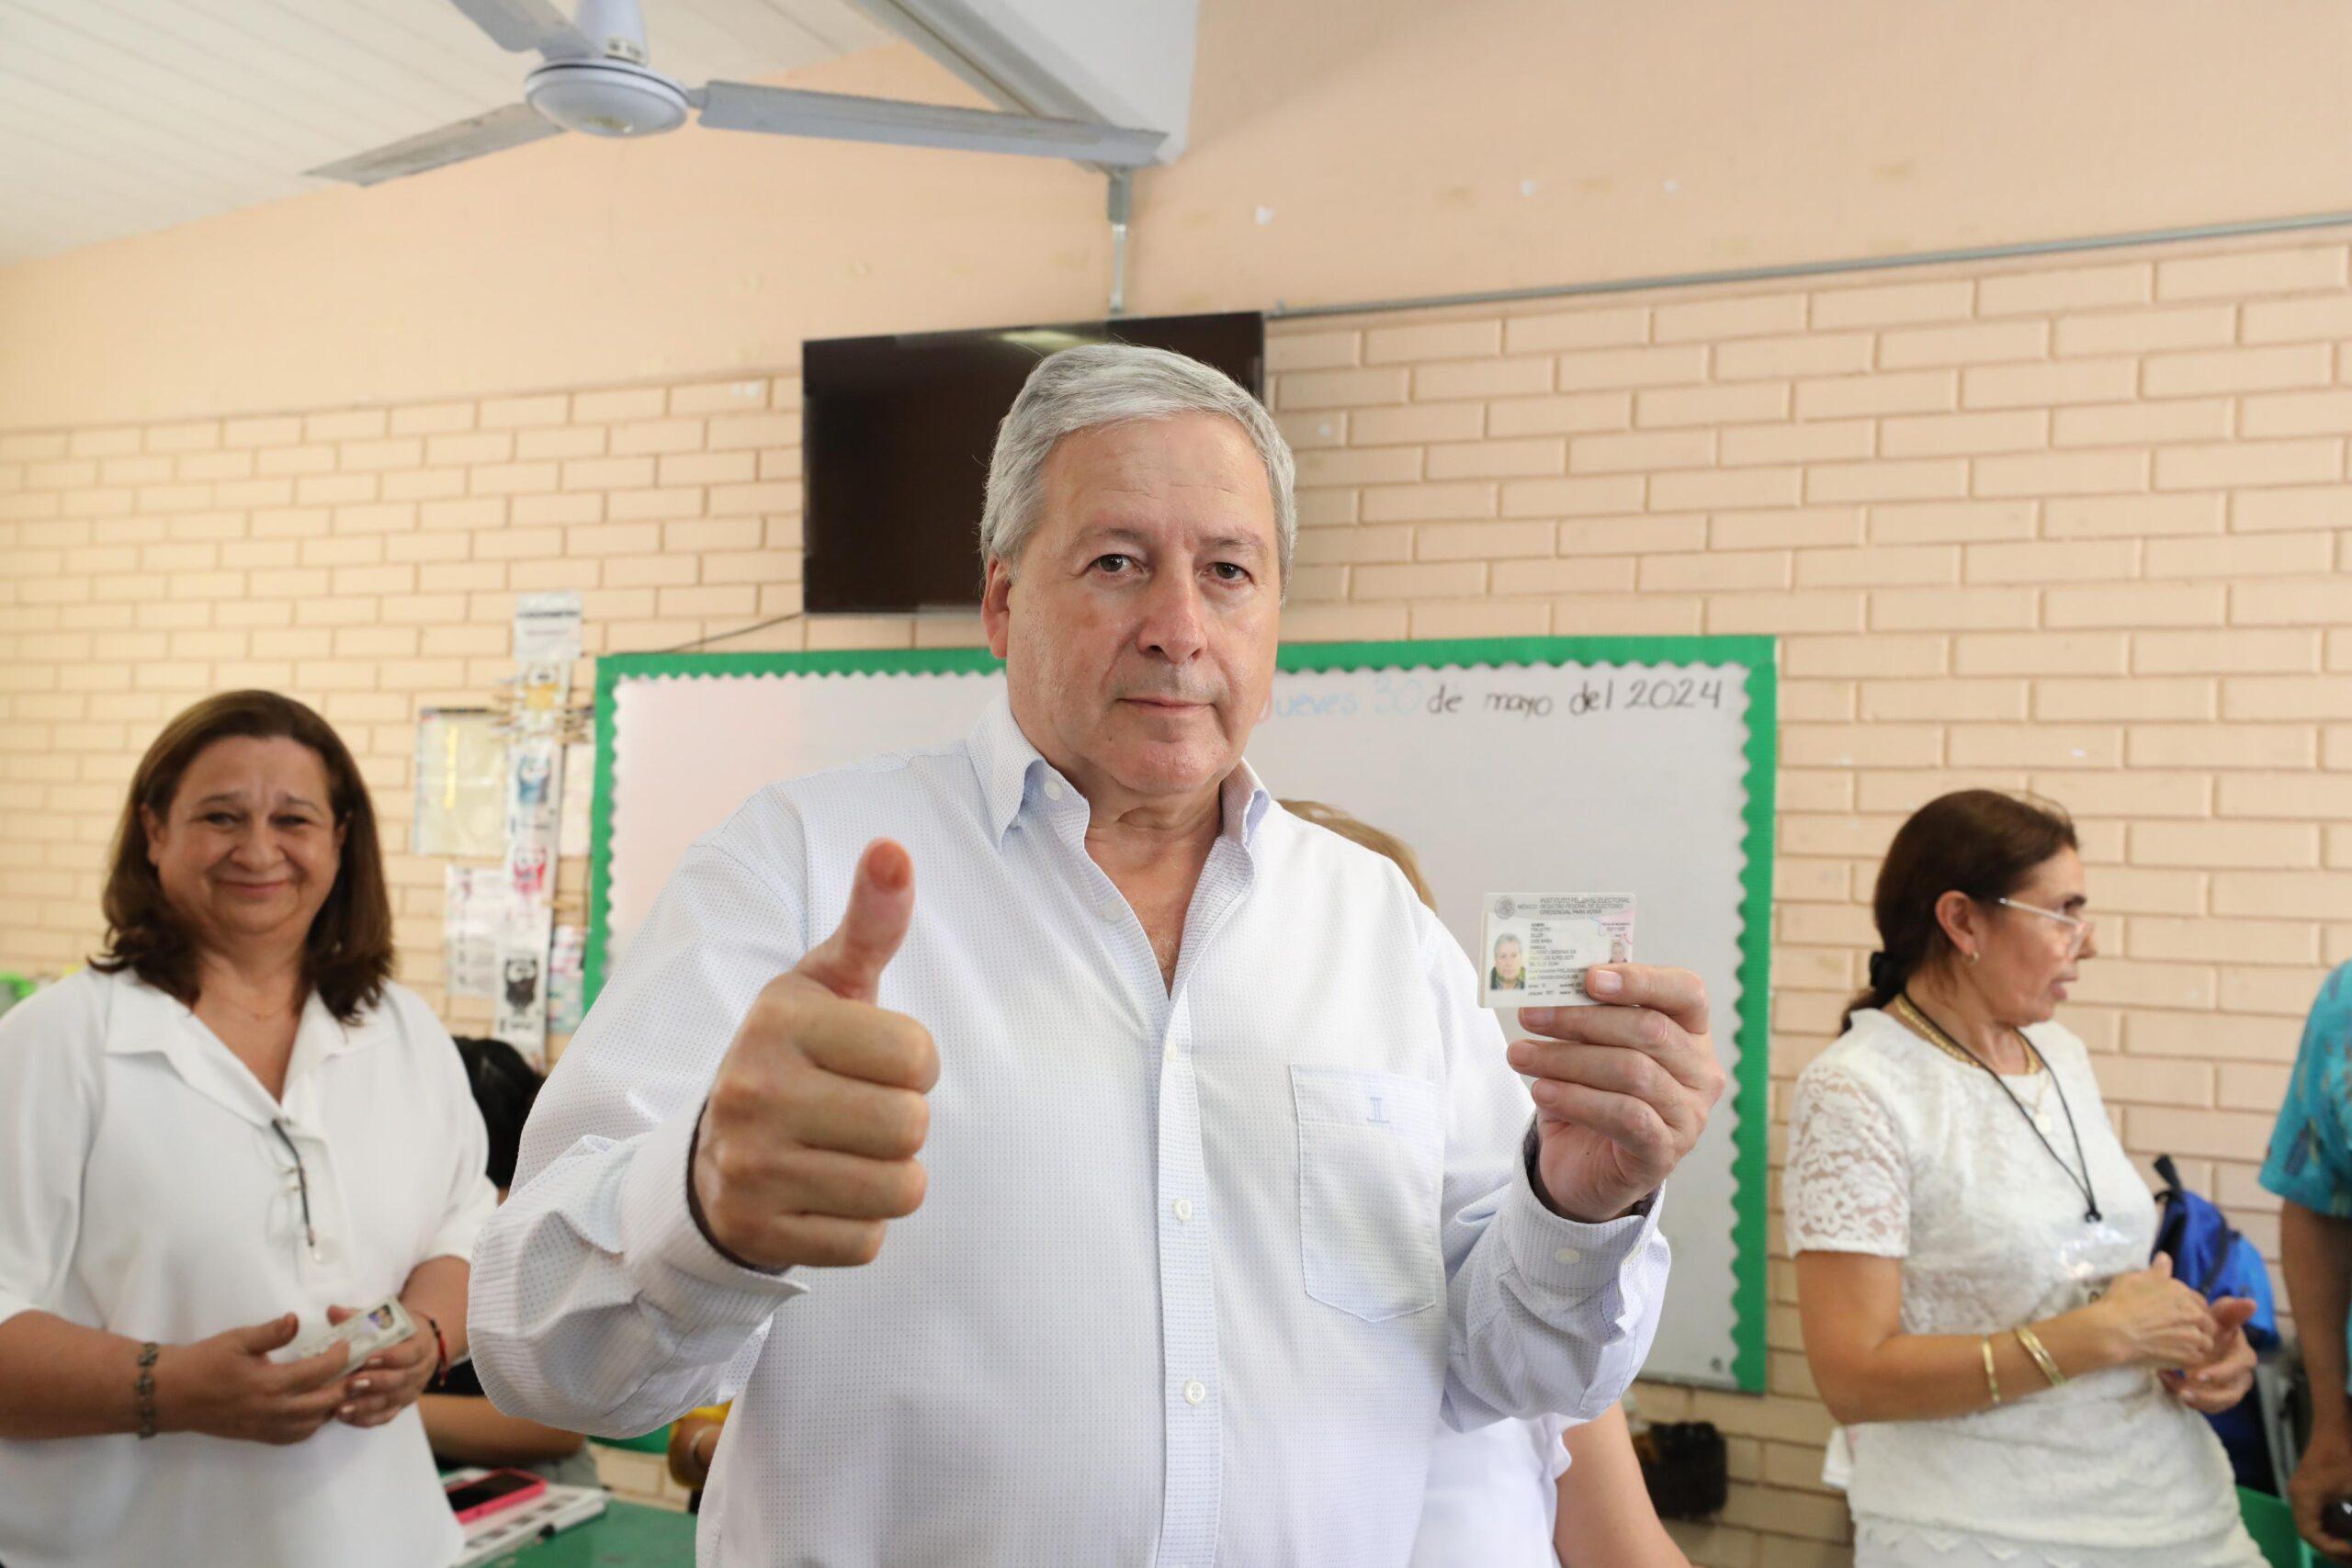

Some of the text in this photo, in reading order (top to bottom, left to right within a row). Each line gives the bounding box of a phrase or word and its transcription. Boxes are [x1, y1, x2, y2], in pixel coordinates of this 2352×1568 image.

[1428, 682, 1463, 714] de
[1486, 689, 1554, 717] mayo
[1569, 678, 1612, 713] del
[1624, 677, 1722, 710] 2024
